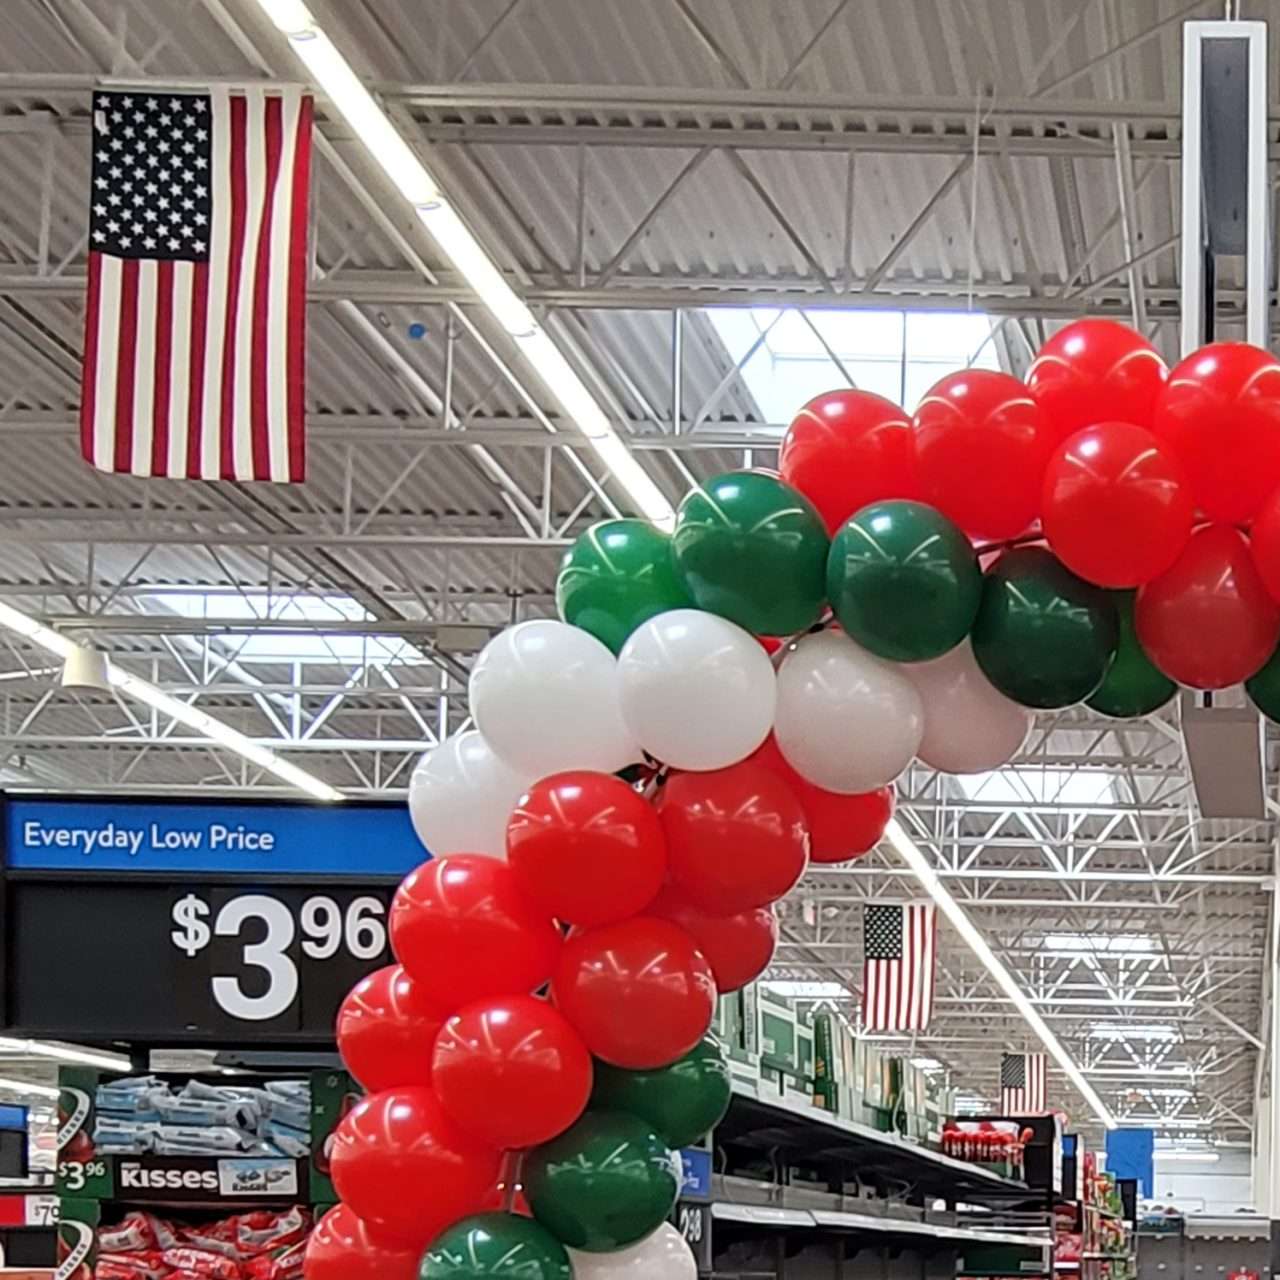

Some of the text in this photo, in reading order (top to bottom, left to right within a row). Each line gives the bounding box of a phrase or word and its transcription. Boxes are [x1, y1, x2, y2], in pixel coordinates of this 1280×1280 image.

[24, 821, 275, 855] Everyday Low Price
